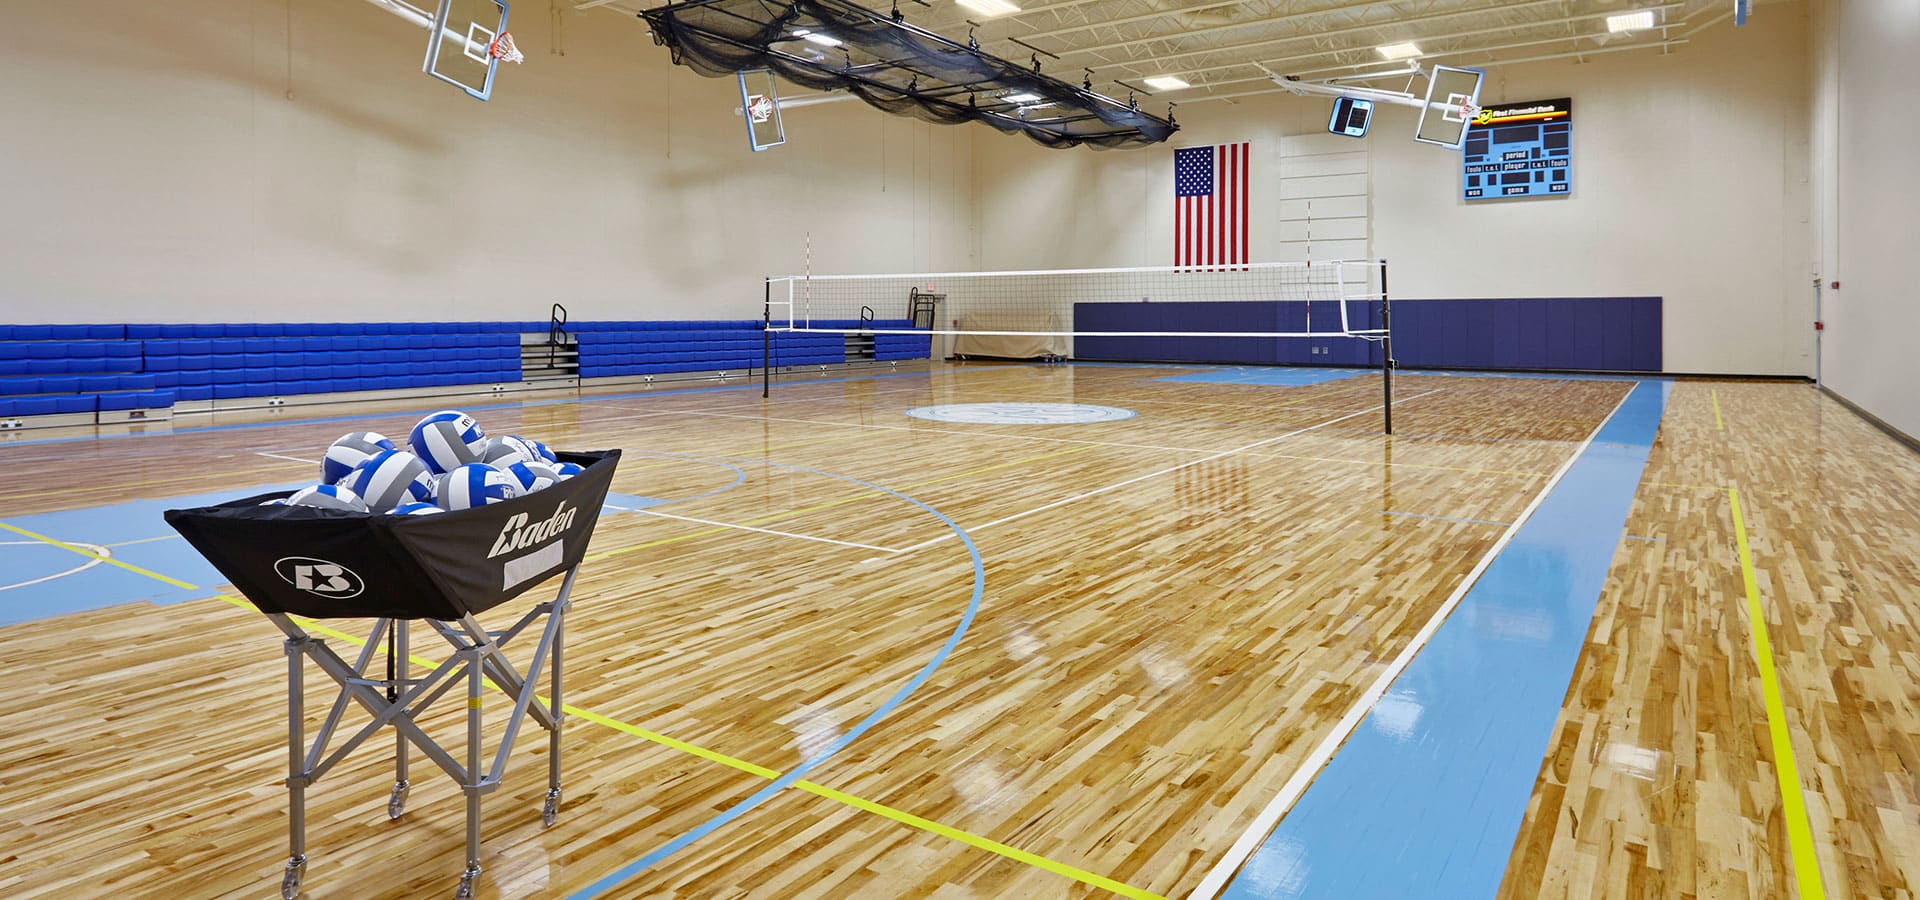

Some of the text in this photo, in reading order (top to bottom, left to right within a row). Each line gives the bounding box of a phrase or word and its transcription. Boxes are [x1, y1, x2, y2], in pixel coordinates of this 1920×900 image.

[1505, 151, 1526, 159] period
[1504, 162, 1526, 170] player
[487, 500, 577, 559] Baden
